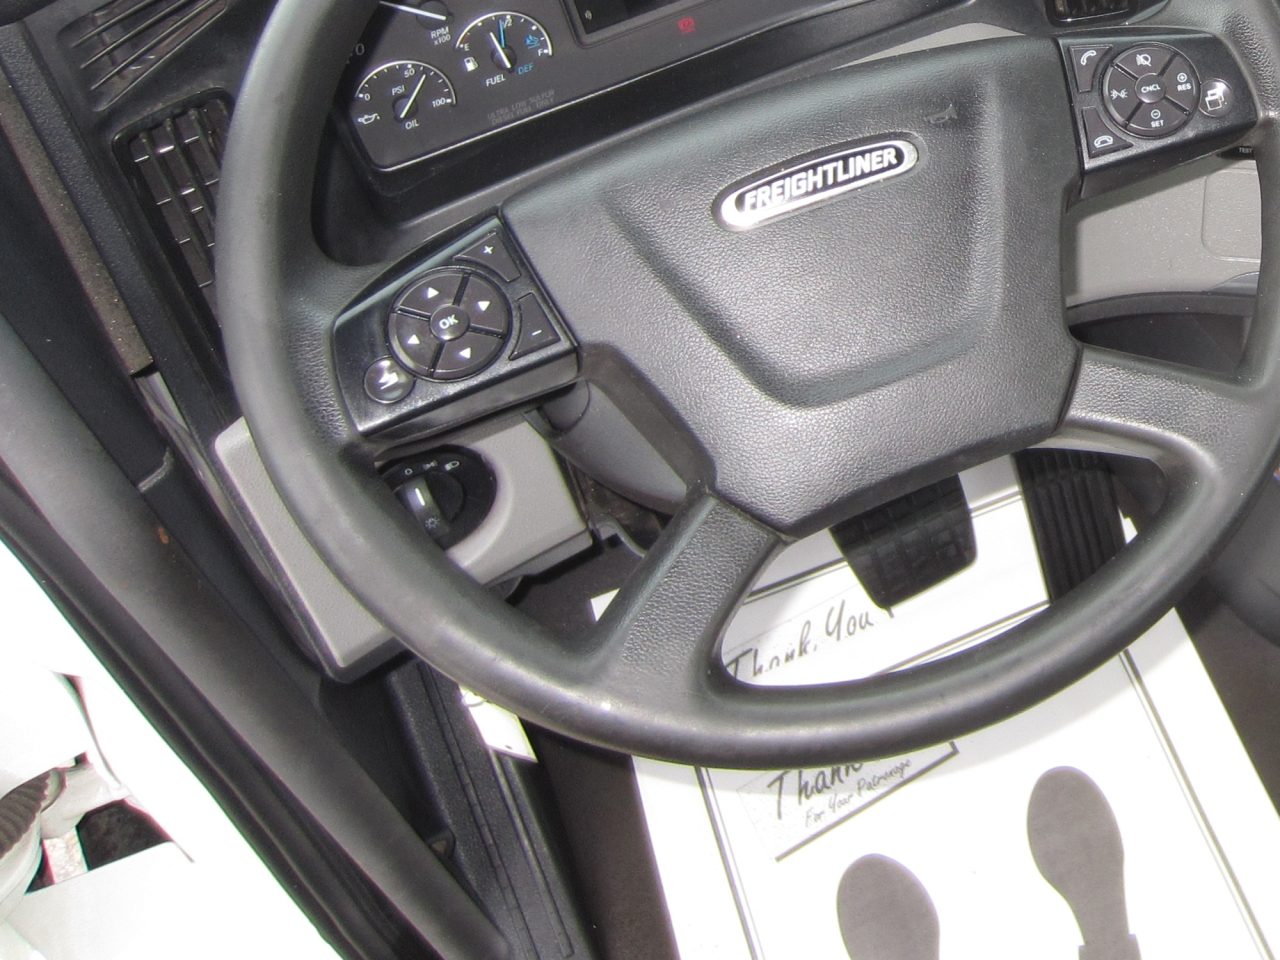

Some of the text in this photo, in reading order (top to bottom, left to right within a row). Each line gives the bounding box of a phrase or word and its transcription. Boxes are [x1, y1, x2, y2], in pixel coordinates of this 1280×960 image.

[431, 26, 449, 39] RPM
[433, 34, 451, 46] x100
[404, 67, 416, 78] 50
[518, 64, 534, 75] DEF
[485, 74, 506, 87] FUEL
[392, 85, 405, 95] PSI
[1141, 84, 1161, 93] CNCL
[1177, 83, 1192, 91] RES
[432, 97, 446, 108] 100
[405, 119, 420, 130] OIL
[743, 146, 898, 214] FREIGHTLINER
[439, 314, 458, 330] OK
[825, 599, 874, 641] You
[804, 759, 911, 827] For Your Patronage
